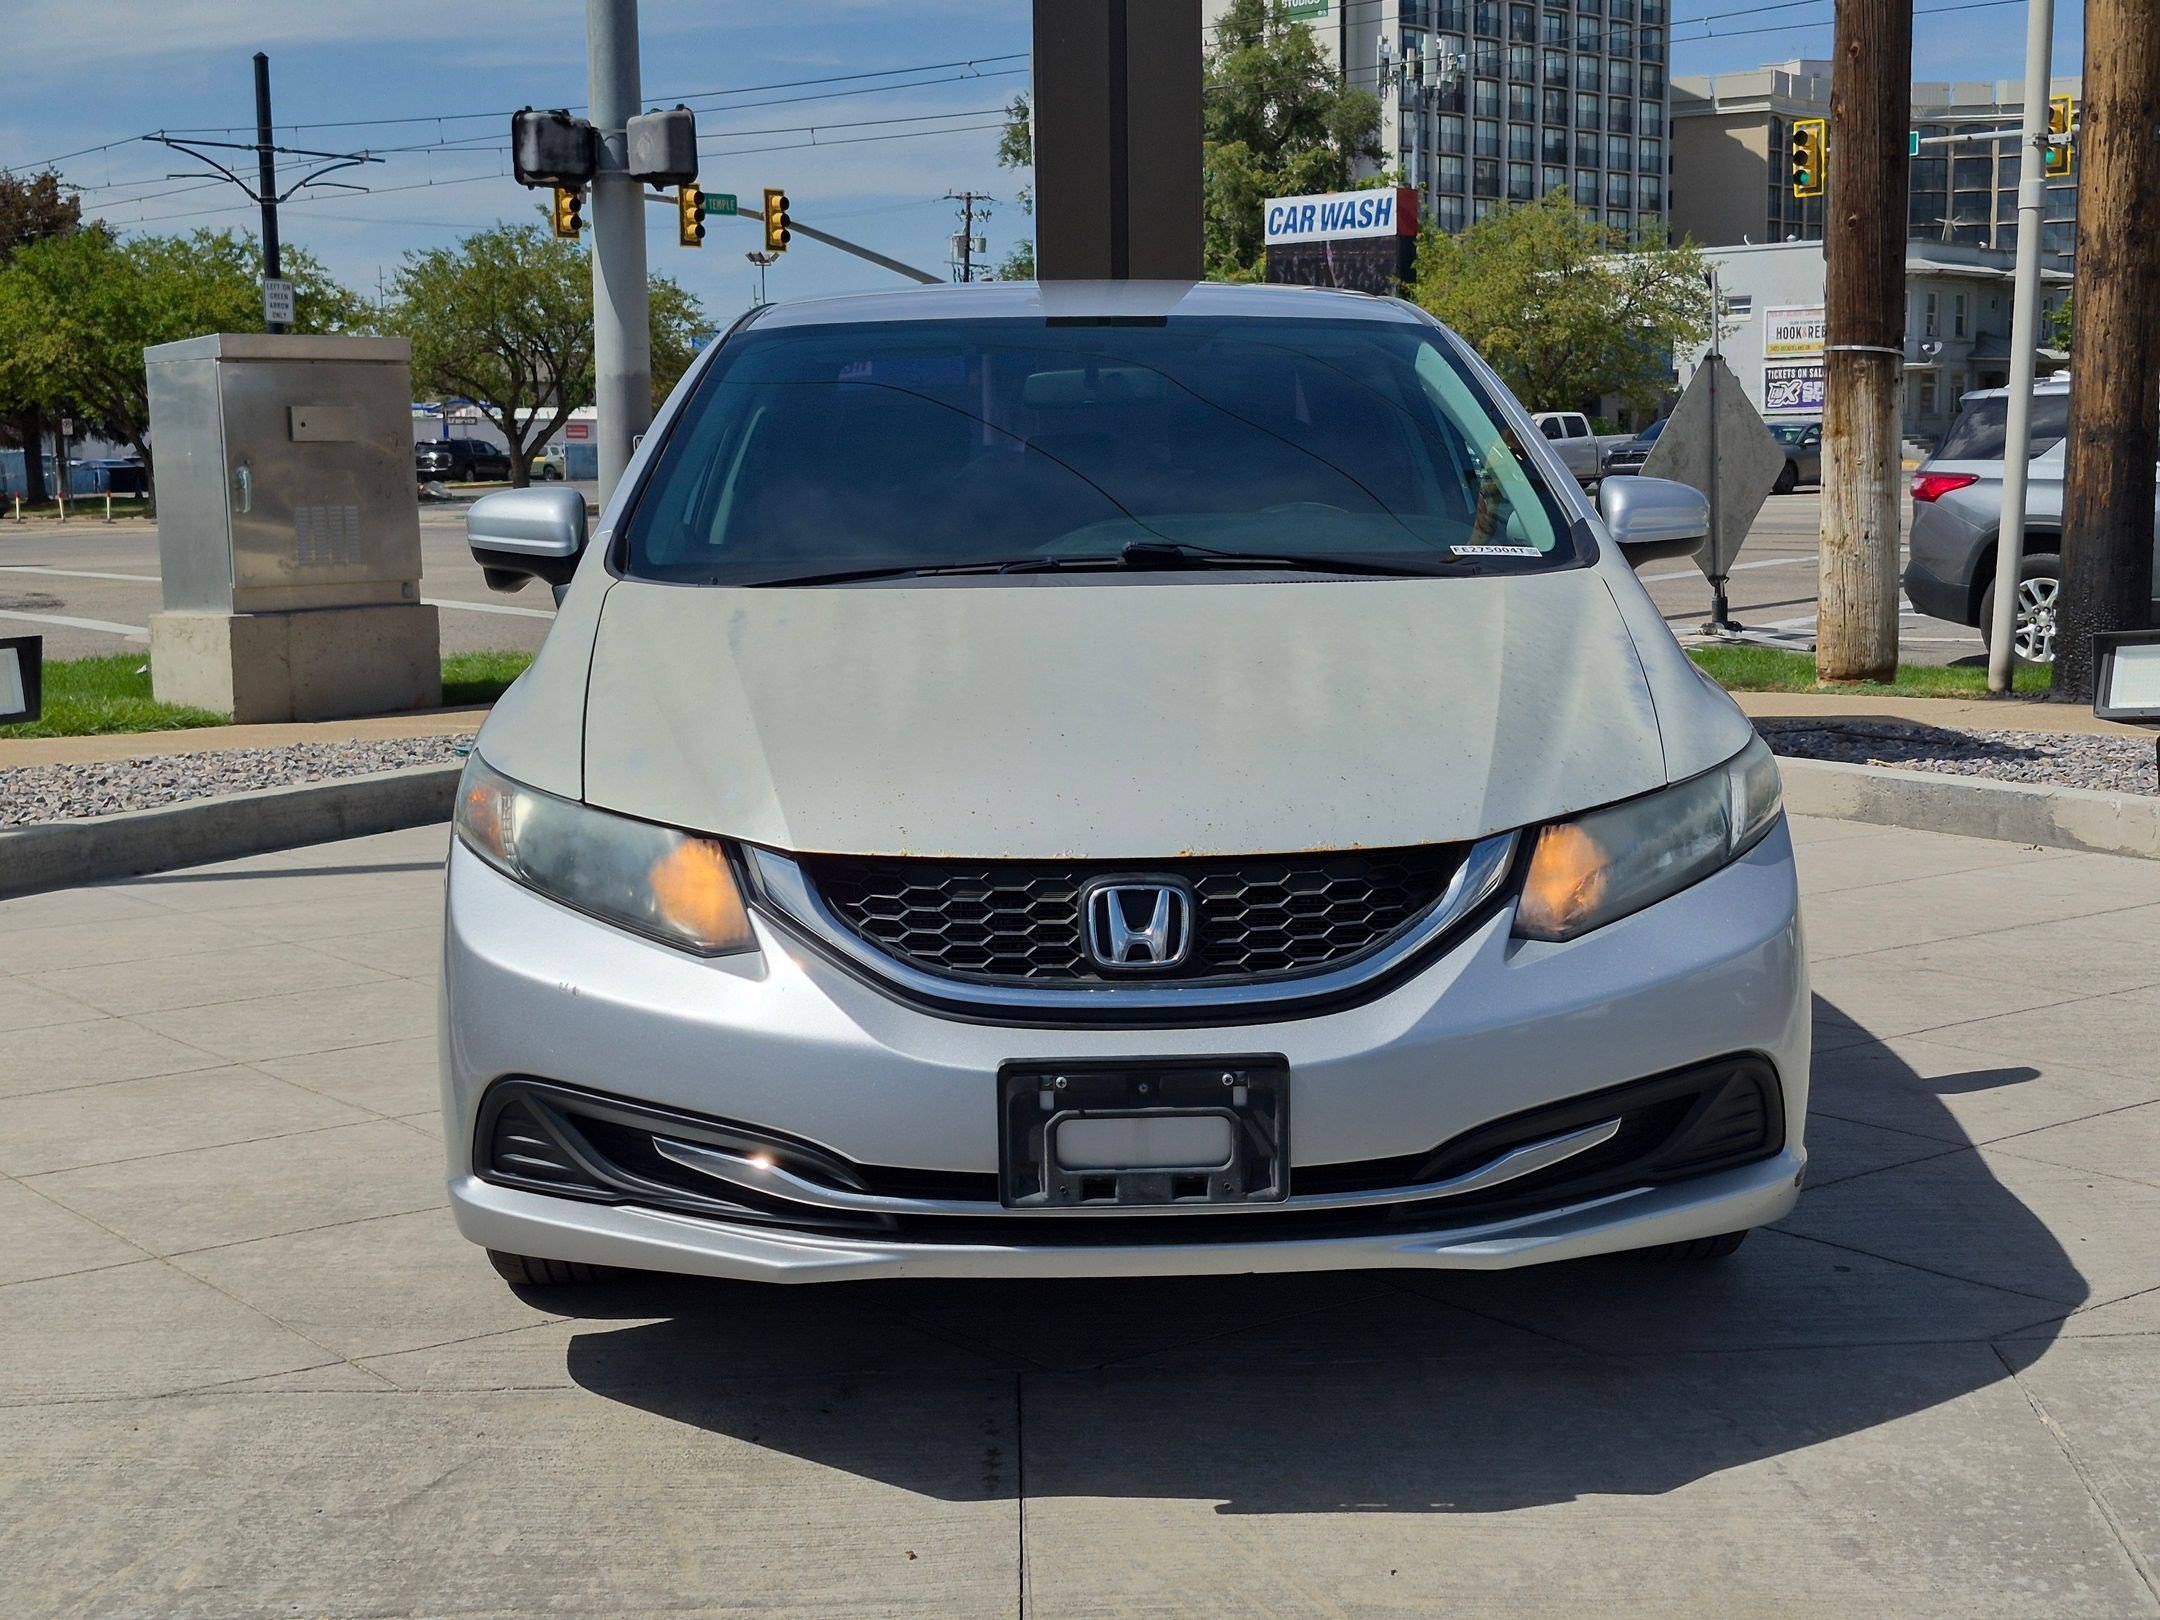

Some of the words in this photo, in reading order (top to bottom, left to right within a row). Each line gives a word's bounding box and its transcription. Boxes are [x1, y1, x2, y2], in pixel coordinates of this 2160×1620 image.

[709, 198, 736, 210] TEMPLE
[1268, 204, 1317, 236] CAR
[1320, 197, 1393, 232] WASH
[266, 282, 280, 290] LEFT
[269, 292, 289, 300] GREEN
[269, 302, 289, 310] ARROW
[272, 311, 287, 319] ONLY
[1776, 326, 1802, 340] HOOK
[1767, 369, 1796, 380] TICKETS
[1797, 368, 1808, 379] ON
